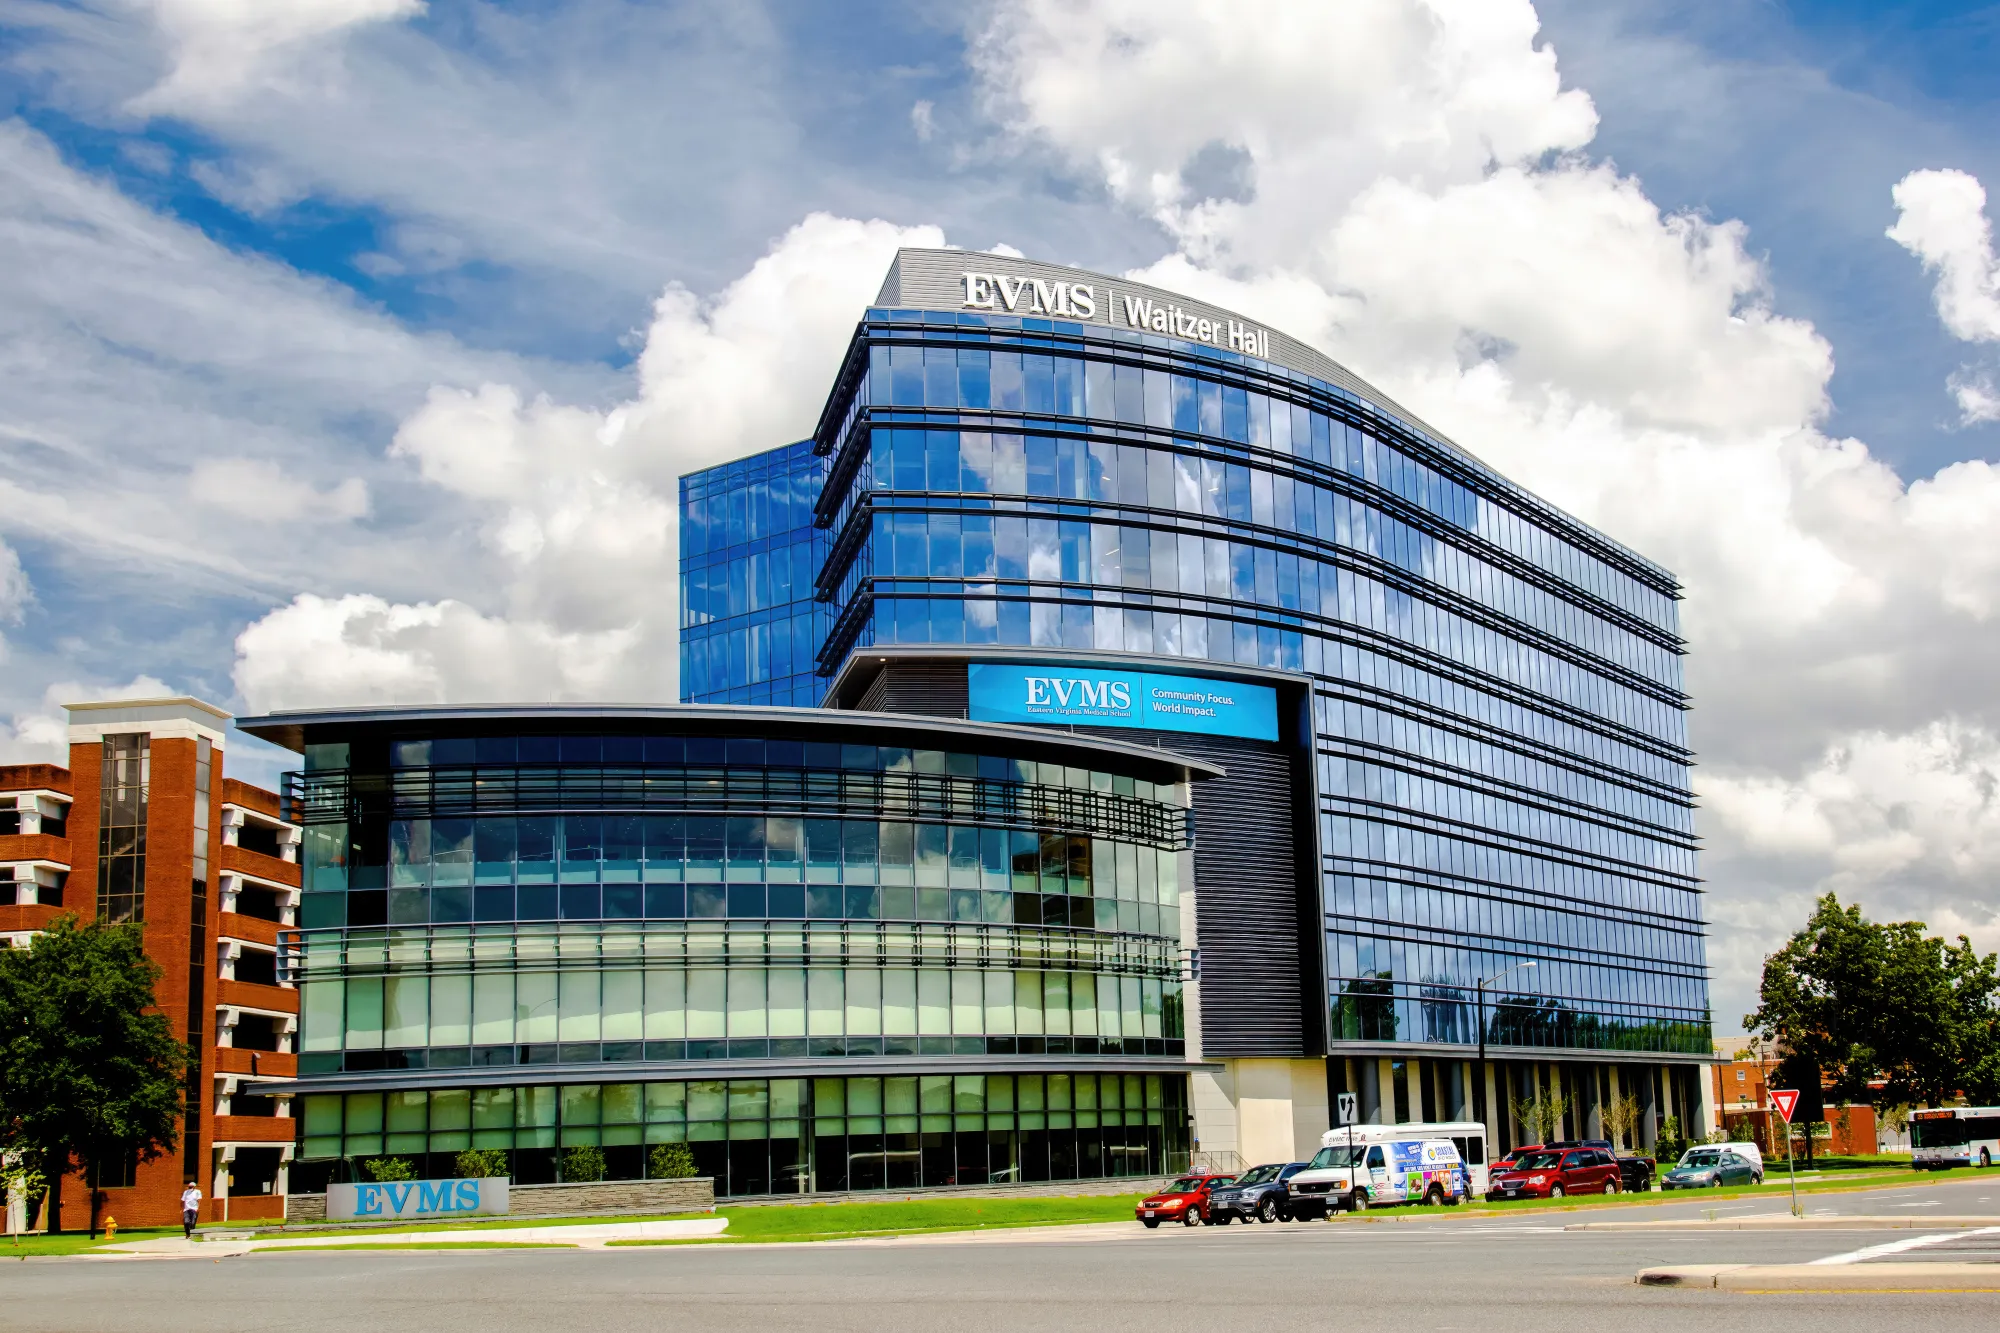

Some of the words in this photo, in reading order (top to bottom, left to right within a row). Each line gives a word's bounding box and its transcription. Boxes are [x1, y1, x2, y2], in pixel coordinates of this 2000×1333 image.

[961, 272, 1096, 319] EVMS
[1124, 295, 1222, 344] Waitzer
[1227, 320, 1270, 359] Hall
[1024, 677, 1132, 710] EVMS
[1151, 687, 1206, 705] Community
[1207, 692, 1235, 706] Focus.
[1027, 706, 1053, 715] Eastern
[1055, 707, 1082, 717] Virginia
[1083, 709, 1108, 717] Medical
[1110, 710, 1131, 718] School
[1152, 701, 1181, 714] World
[1182, 704, 1217, 717] Impact.
[353, 1179, 480, 1216] EVMS
